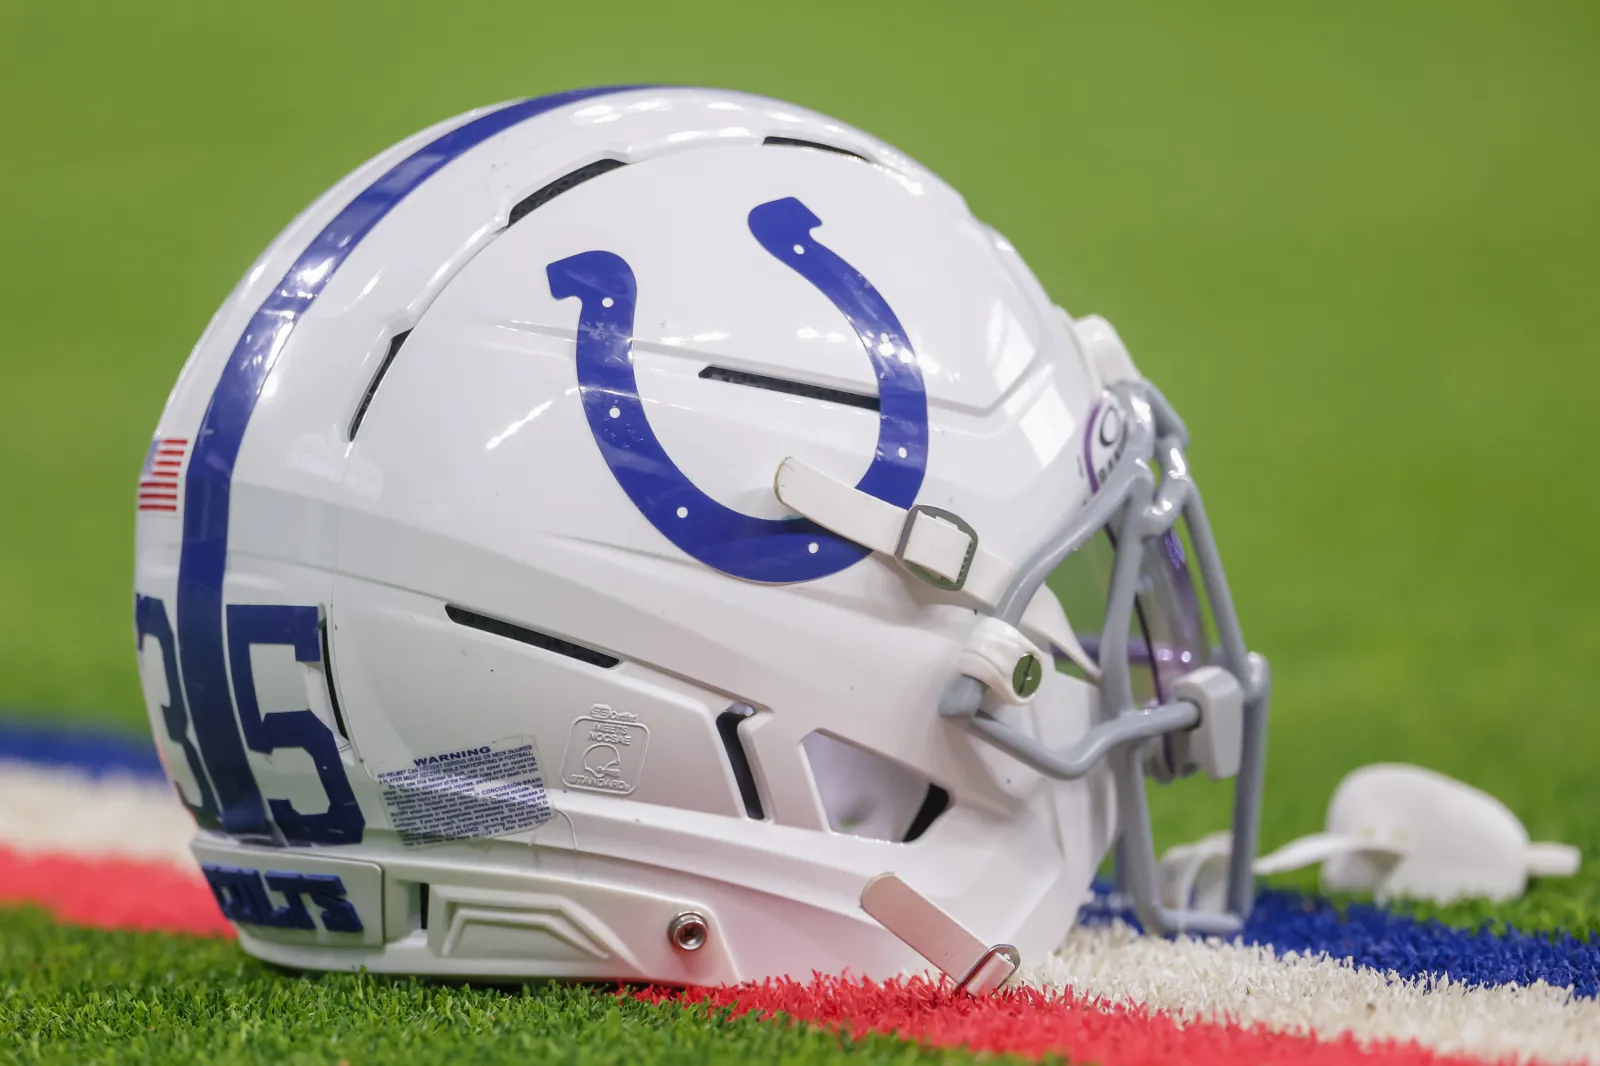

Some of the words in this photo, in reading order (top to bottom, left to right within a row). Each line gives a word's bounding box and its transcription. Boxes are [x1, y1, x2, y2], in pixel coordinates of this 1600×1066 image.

[594, 722, 628, 734] MEETS
[588, 731, 631, 745] NOCSAE
[413, 745, 491, 766] WARNING
